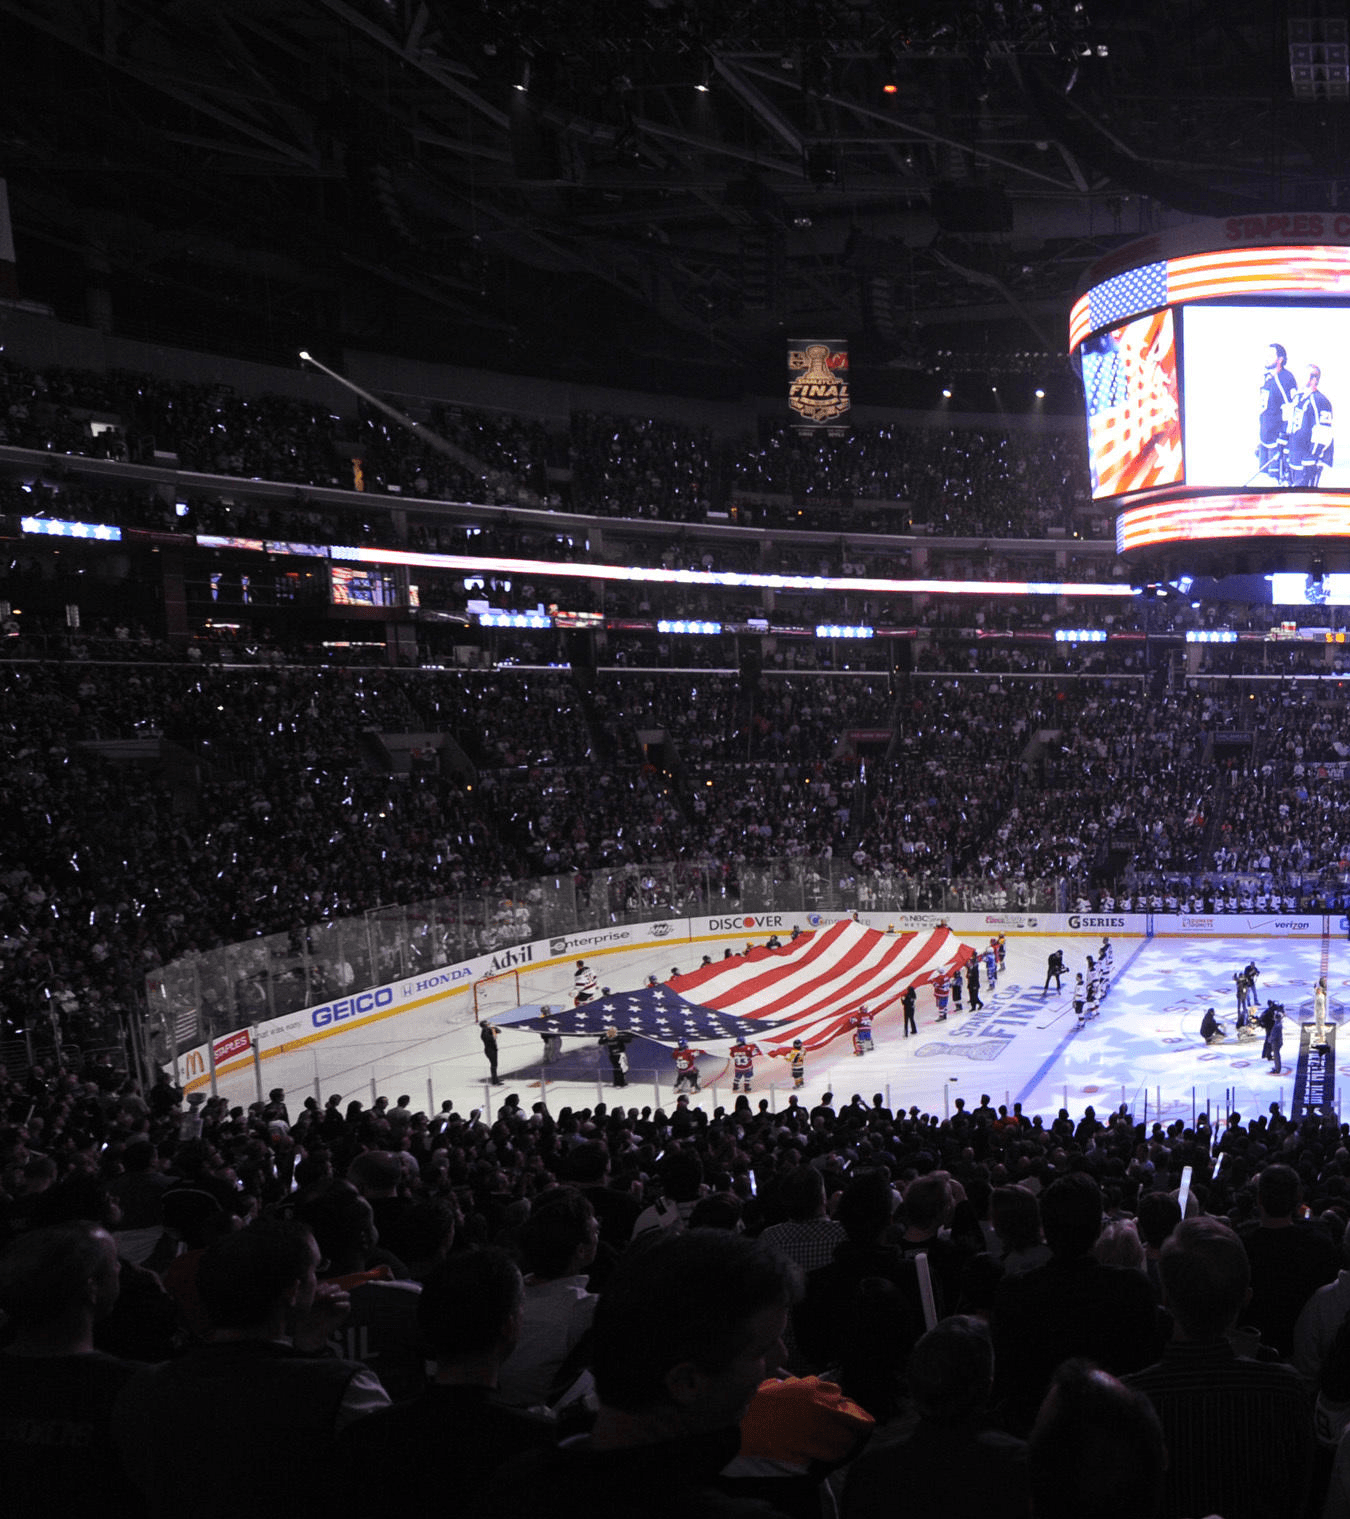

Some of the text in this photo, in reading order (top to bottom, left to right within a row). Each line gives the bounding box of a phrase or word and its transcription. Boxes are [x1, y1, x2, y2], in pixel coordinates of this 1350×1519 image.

[1226, 213, 1323, 241] STAPLES
[788, 384, 850, 398] FINAL
[709, 916, 783, 931] DISCOVER
[1082, 917, 1125, 927] SERIES
[1275, 921, 1310, 930] verizon
[552, 929, 630, 954] enterprise
[490, 945, 533, 972] Advil
[416, 967, 473, 992] HONDA
[312, 987, 393, 1028] GEICO
[213, 1035, 248, 1060] STAPLES
